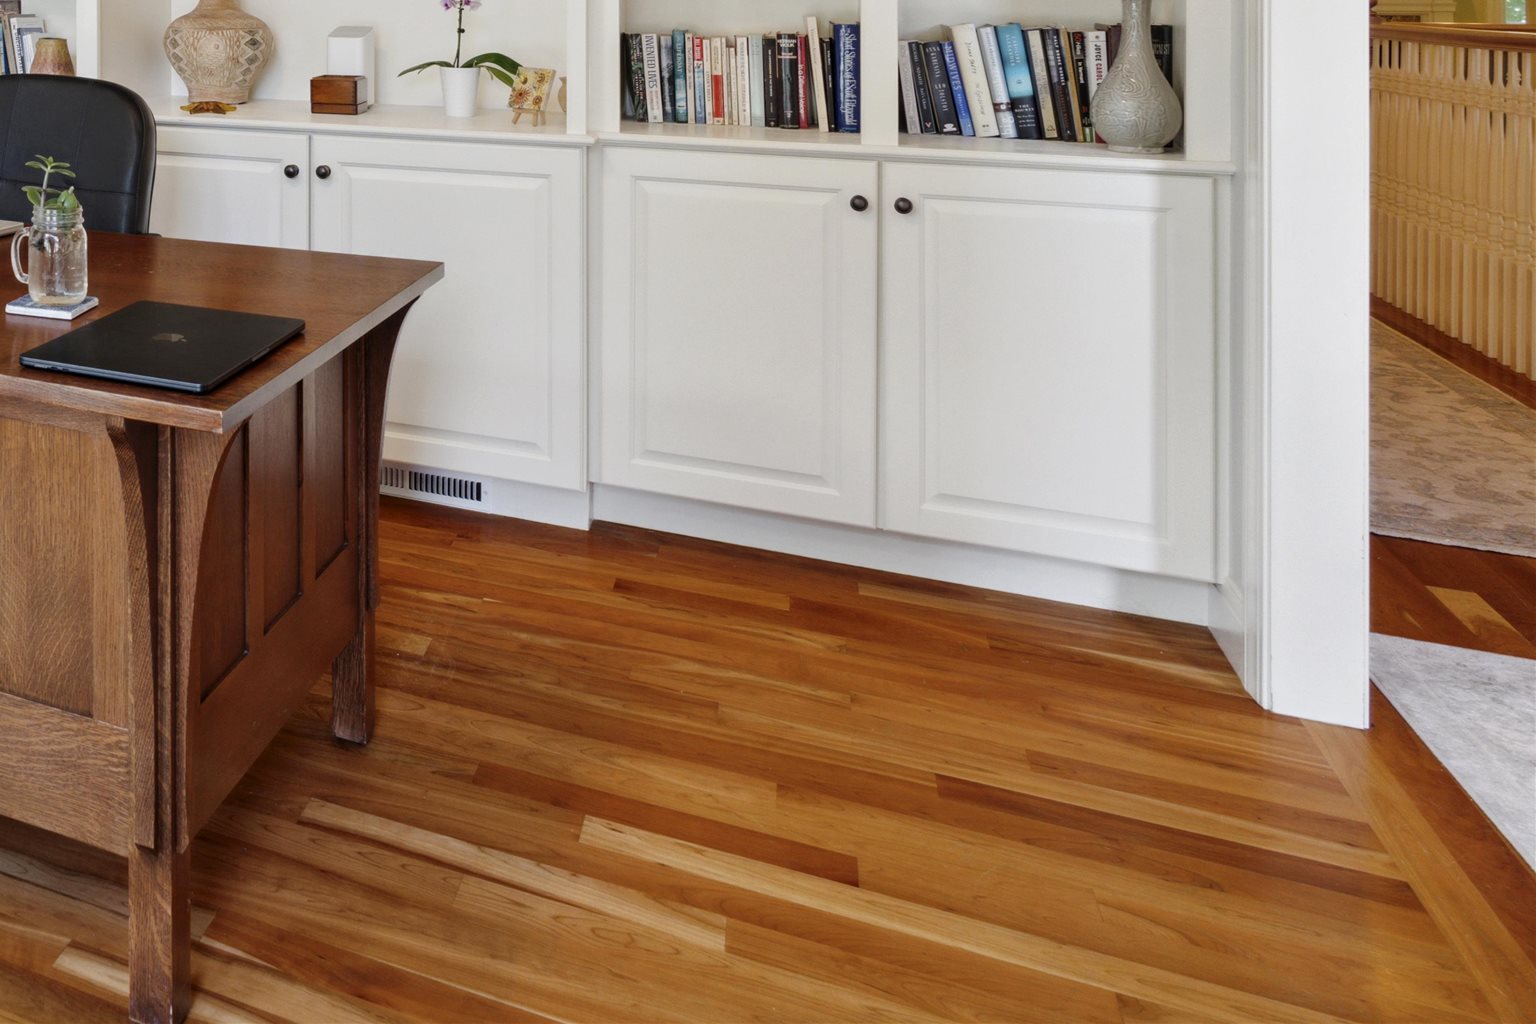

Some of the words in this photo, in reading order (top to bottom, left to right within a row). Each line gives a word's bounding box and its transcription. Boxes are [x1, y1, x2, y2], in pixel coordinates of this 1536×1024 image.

[845, 33, 858, 51] Short
[1074, 33, 1083, 42] 50
[644, 35, 657, 69] INVENTED
[1005, 34, 1015, 67] ALEXANDER
[1011, 36, 1021, 64] CAROLINE
[1094, 44, 1102, 61] JOYCE
[844, 52, 858, 72] Stories
[945, 45, 962, 91] MIDWIVES
[648, 70, 658, 89] LIVES
[1058, 67, 1066, 86] HORSES
[1096, 63, 1104, 81] CAROL
[845, 85, 857, 98] Scott
[841, 99, 858, 126] Fitzgerald
